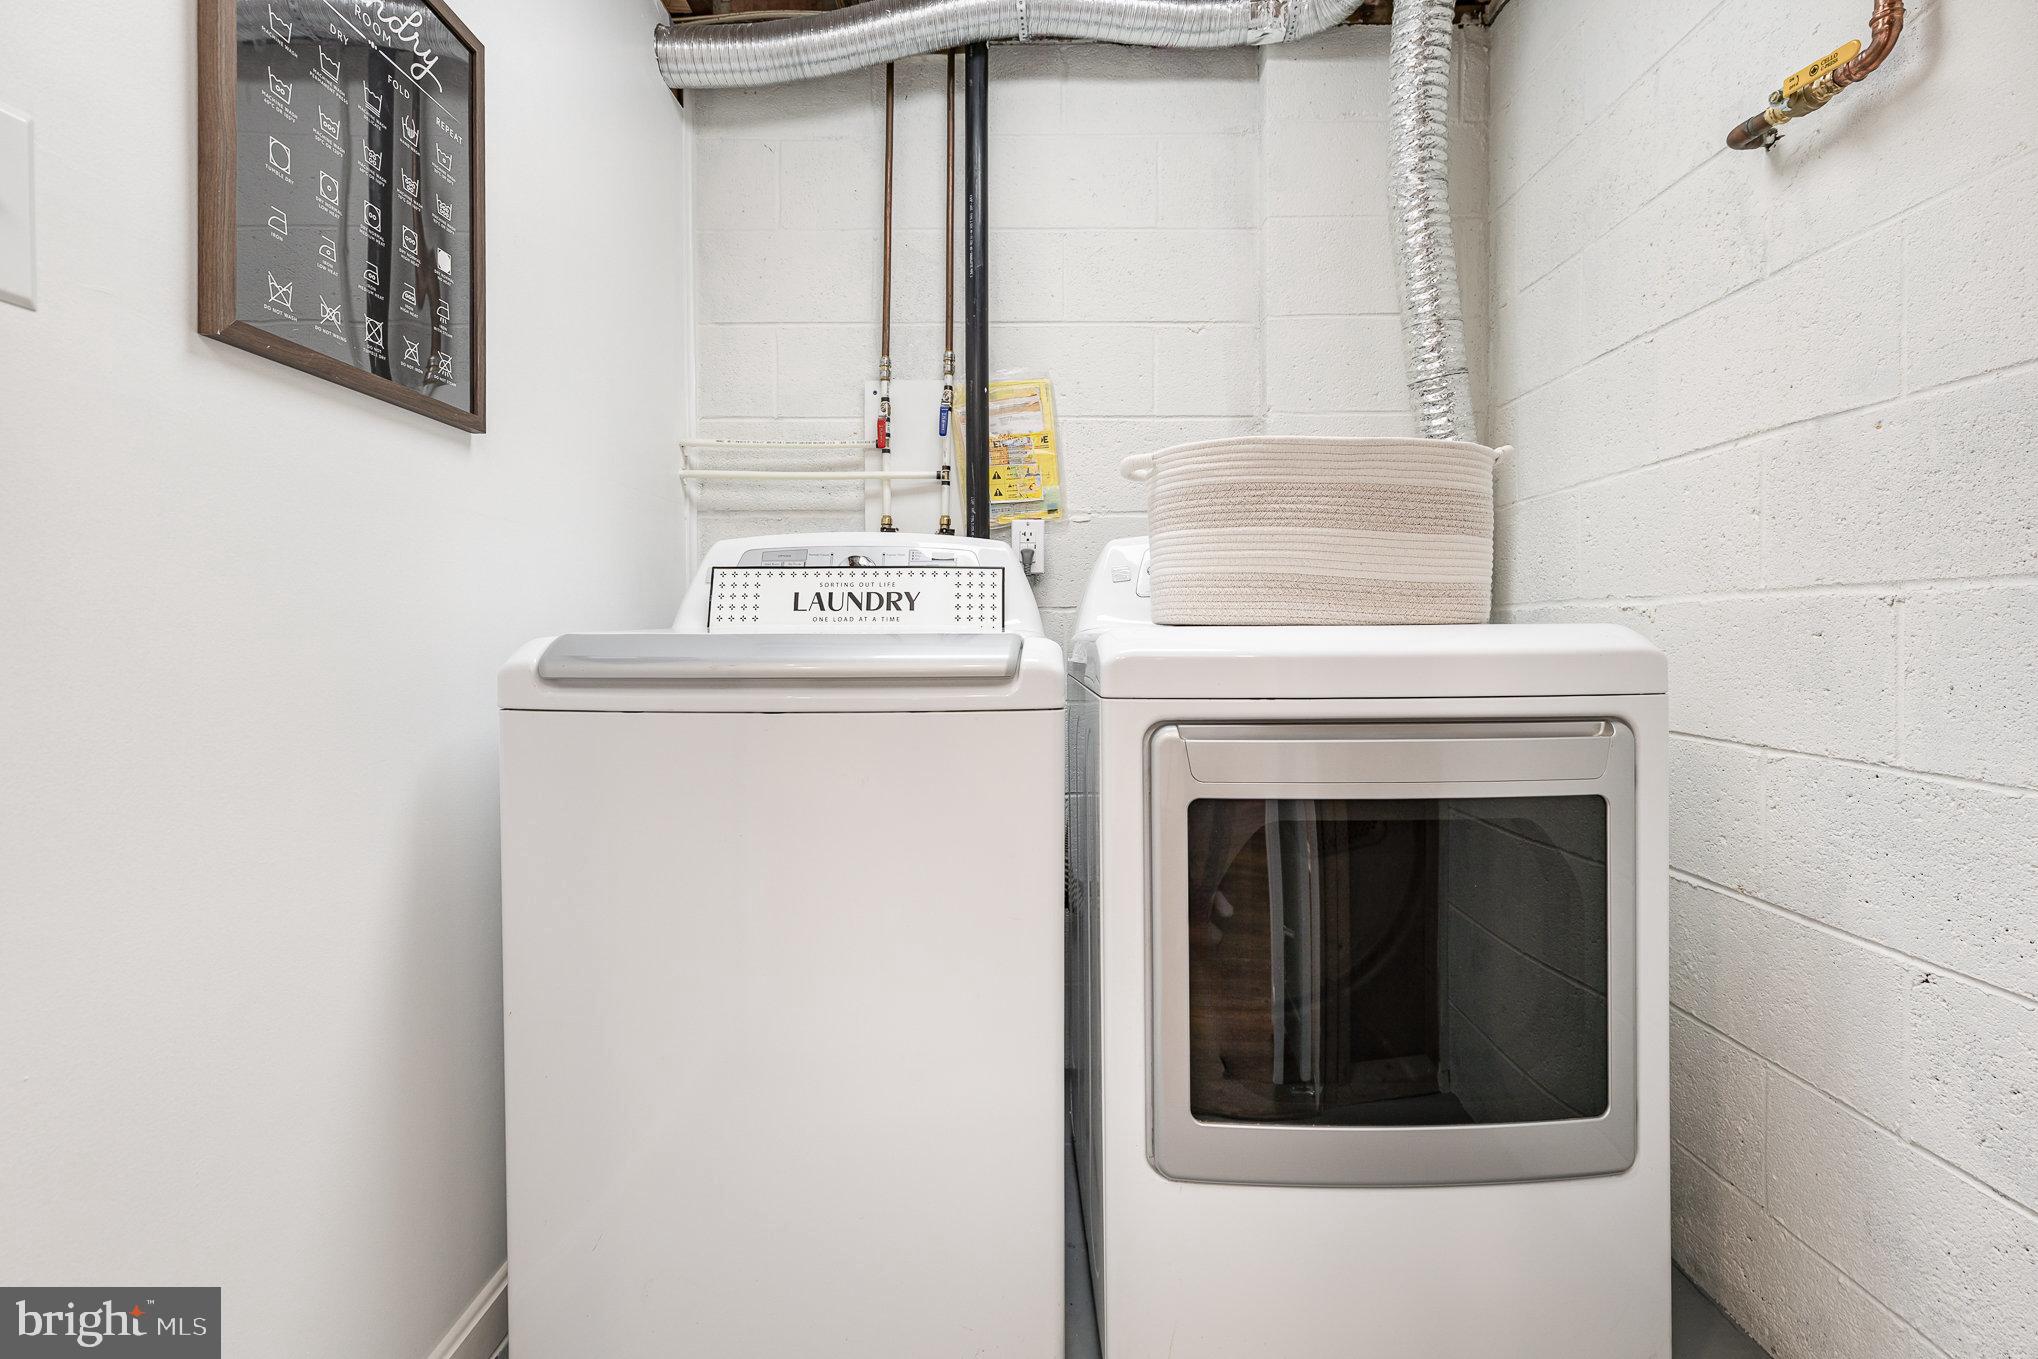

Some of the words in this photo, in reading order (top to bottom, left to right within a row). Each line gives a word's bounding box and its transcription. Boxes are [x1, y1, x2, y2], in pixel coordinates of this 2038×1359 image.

[330, 22, 348, 46] DRY
[354, 4, 391, 47] ROOM
[1820, 52, 1838, 66] CELLO
[387, 74, 410, 99] FOLD
[436, 116, 462, 144] REPEAT
[265, 164, 284, 180] TUMBLE
[284, 176, 294, 185] DRY
[318, 204, 328, 213] LOW
[270, 232, 284, 242] IRON
[272, 307, 284, 316] NOT
[284, 312, 298, 322] WASH
[792, 592, 921, 612] LAUNDRY
